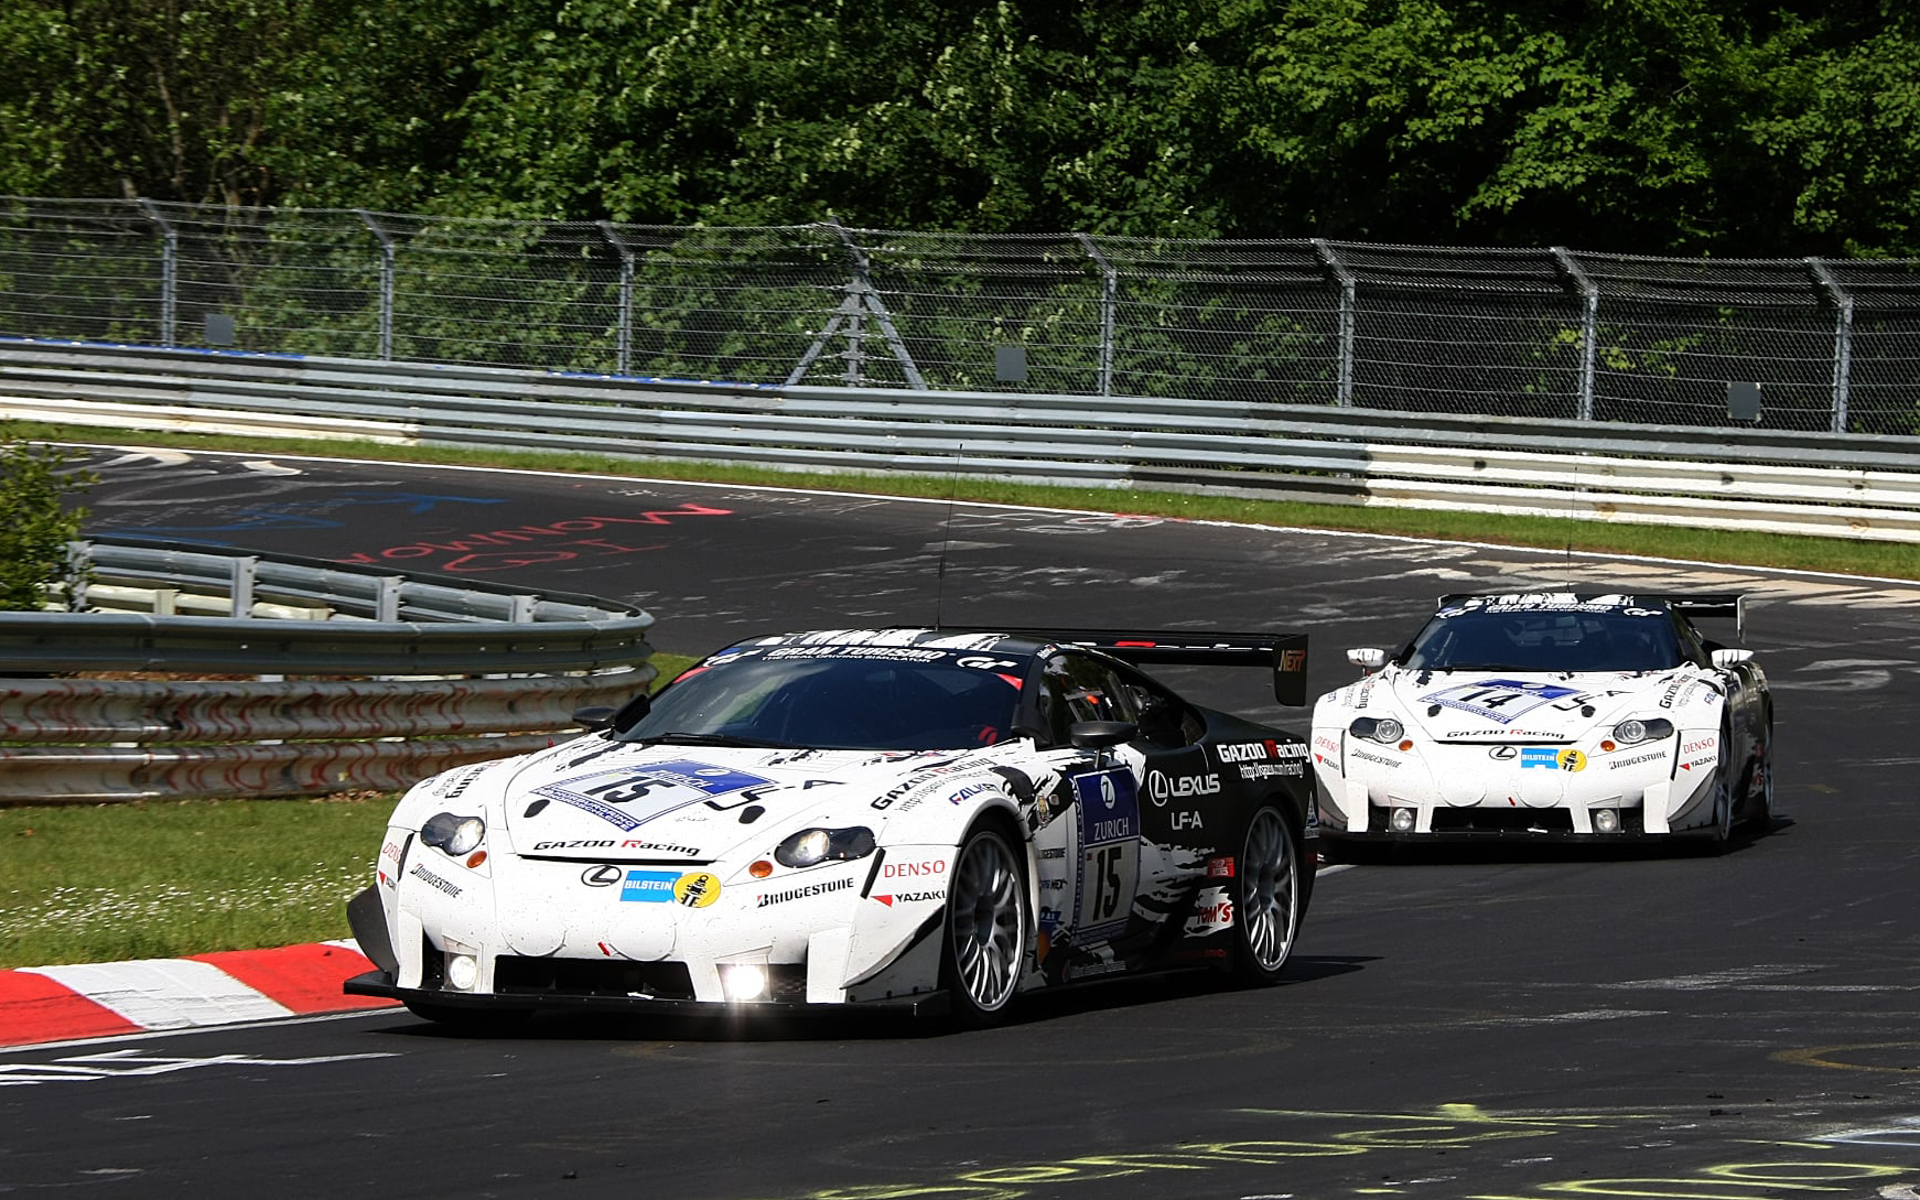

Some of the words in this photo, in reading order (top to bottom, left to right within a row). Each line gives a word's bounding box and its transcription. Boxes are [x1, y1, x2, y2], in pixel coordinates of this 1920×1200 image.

[767, 645, 843, 657] GRAN
[845, 646, 947, 661] TURISMO
[1457, 688, 1523, 709] 14
[1314, 736, 1340, 753] DENSO
[1446, 729, 1505, 739] GAZOO
[1509, 729, 1565, 740] Racing
[1216, 742, 1268, 763] GAZOO
[1265, 739, 1312, 763] Racing
[1683, 737, 1715, 755] DENSO
[1350, 748, 1402, 769] BRIDGESTONE
[1521, 753, 1556, 762] BILSTEIN
[1608, 750, 1668, 770] BRIDGESTONE
[1690, 755, 1717, 768] YAZAKI
[583, 776, 677, 804] 15
[869, 772, 939, 811] GAZOO
[931, 757, 999, 775] Racing
[1169, 773, 1221, 797] LEXUS
[1093, 816, 1130, 842] ZURICH
[1171, 810, 1204, 831] LF-A
[381, 841, 402, 865] DENS
[533, 840, 616, 852] GAZOO
[620, 839, 701, 858] Racing
[883, 860, 946, 878] DENSO
[409, 863, 464, 899] BRIDGESTONE
[623, 879, 673, 892] BILSTEIN
[1092, 845, 1122, 921] 15
[756, 877, 855, 909] BRIDGESTONE
[894, 890, 948, 903] YAZAKI
[1197, 902, 1232, 925] TOM'S
